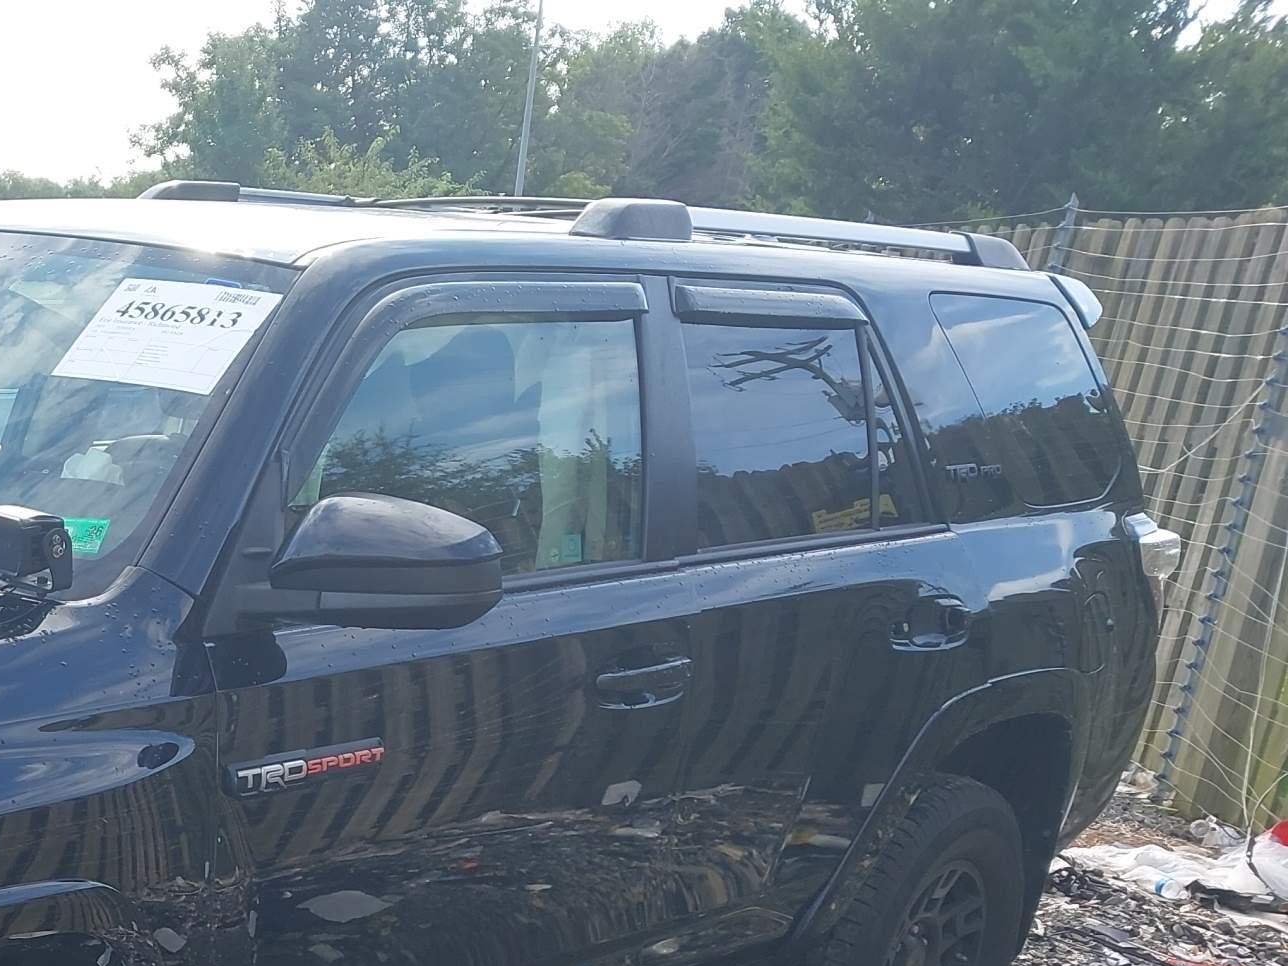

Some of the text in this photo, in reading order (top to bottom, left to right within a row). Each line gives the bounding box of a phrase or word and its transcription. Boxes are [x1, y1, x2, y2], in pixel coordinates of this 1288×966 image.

[116, 299, 243, 330] 45865813
[237, 747, 385, 791] TRD SPORT
